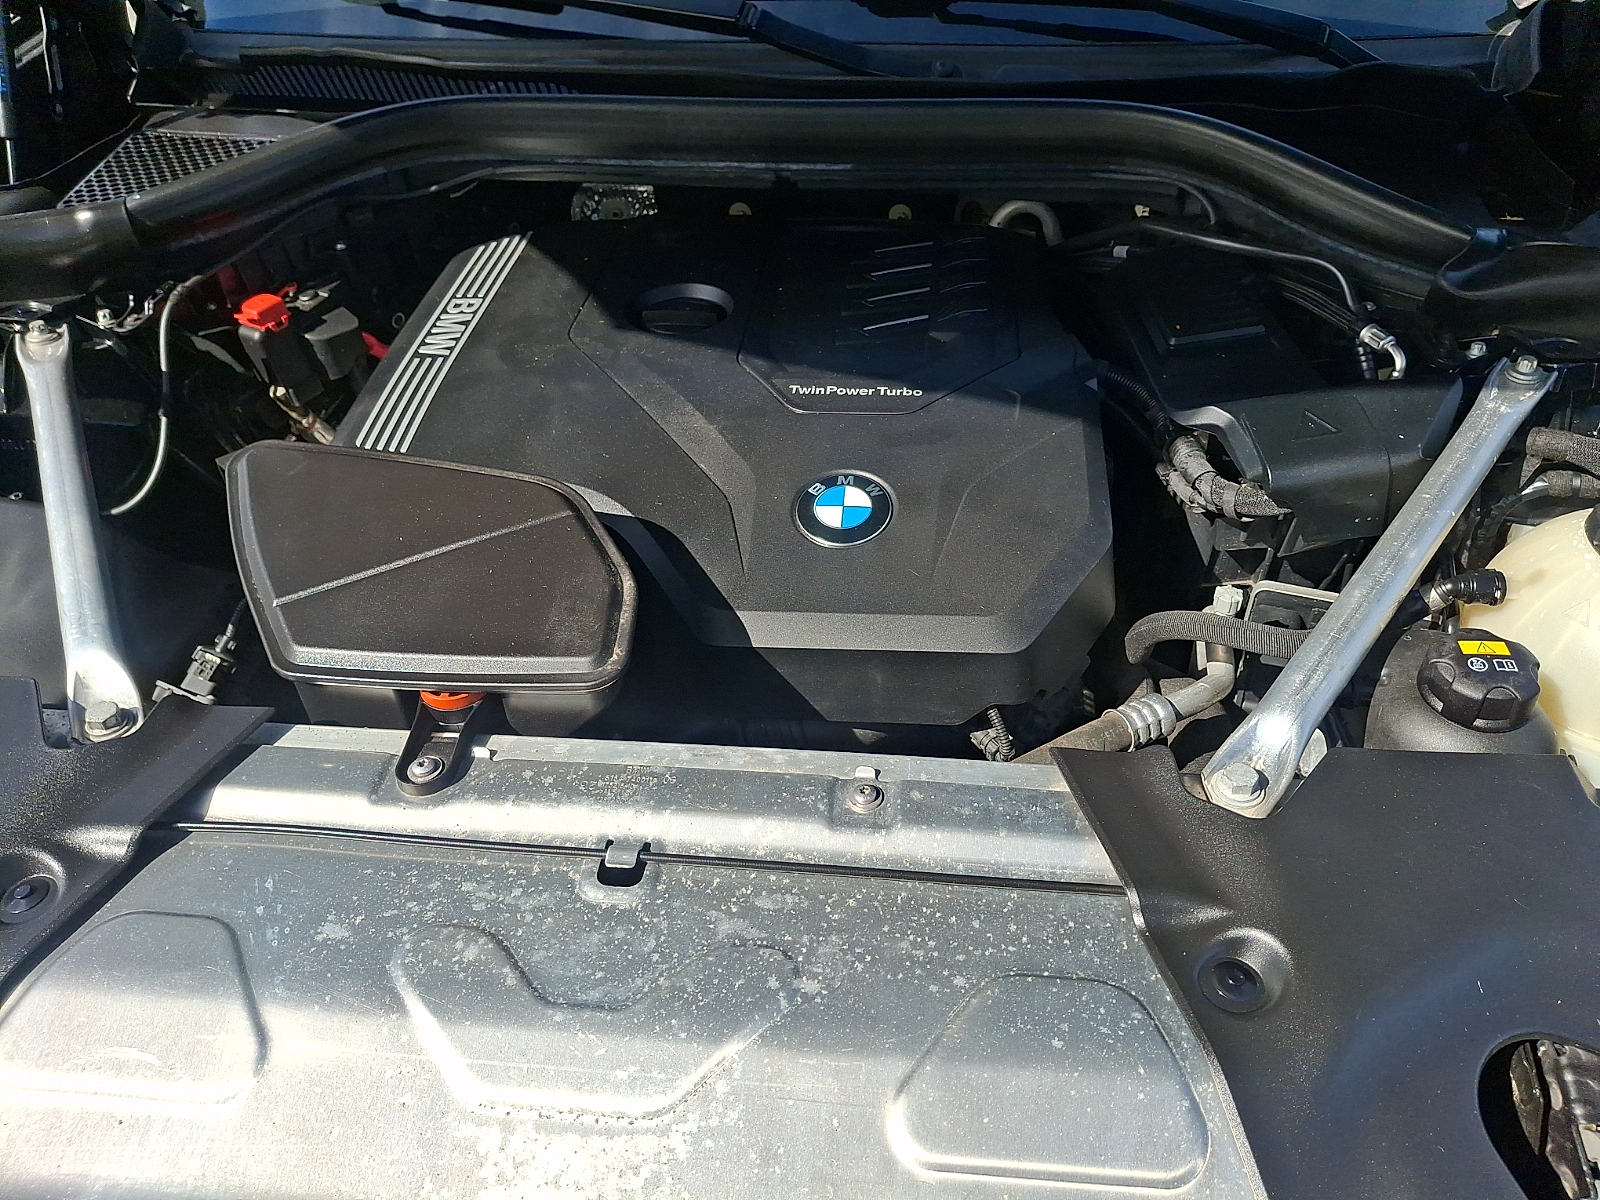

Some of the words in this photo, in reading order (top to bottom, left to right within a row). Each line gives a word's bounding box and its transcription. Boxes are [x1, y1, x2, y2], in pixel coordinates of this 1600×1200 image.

[417, 298, 484, 356] BMW
[876, 386, 923, 397] Turbo
[807, 475, 884, 497] BMW
